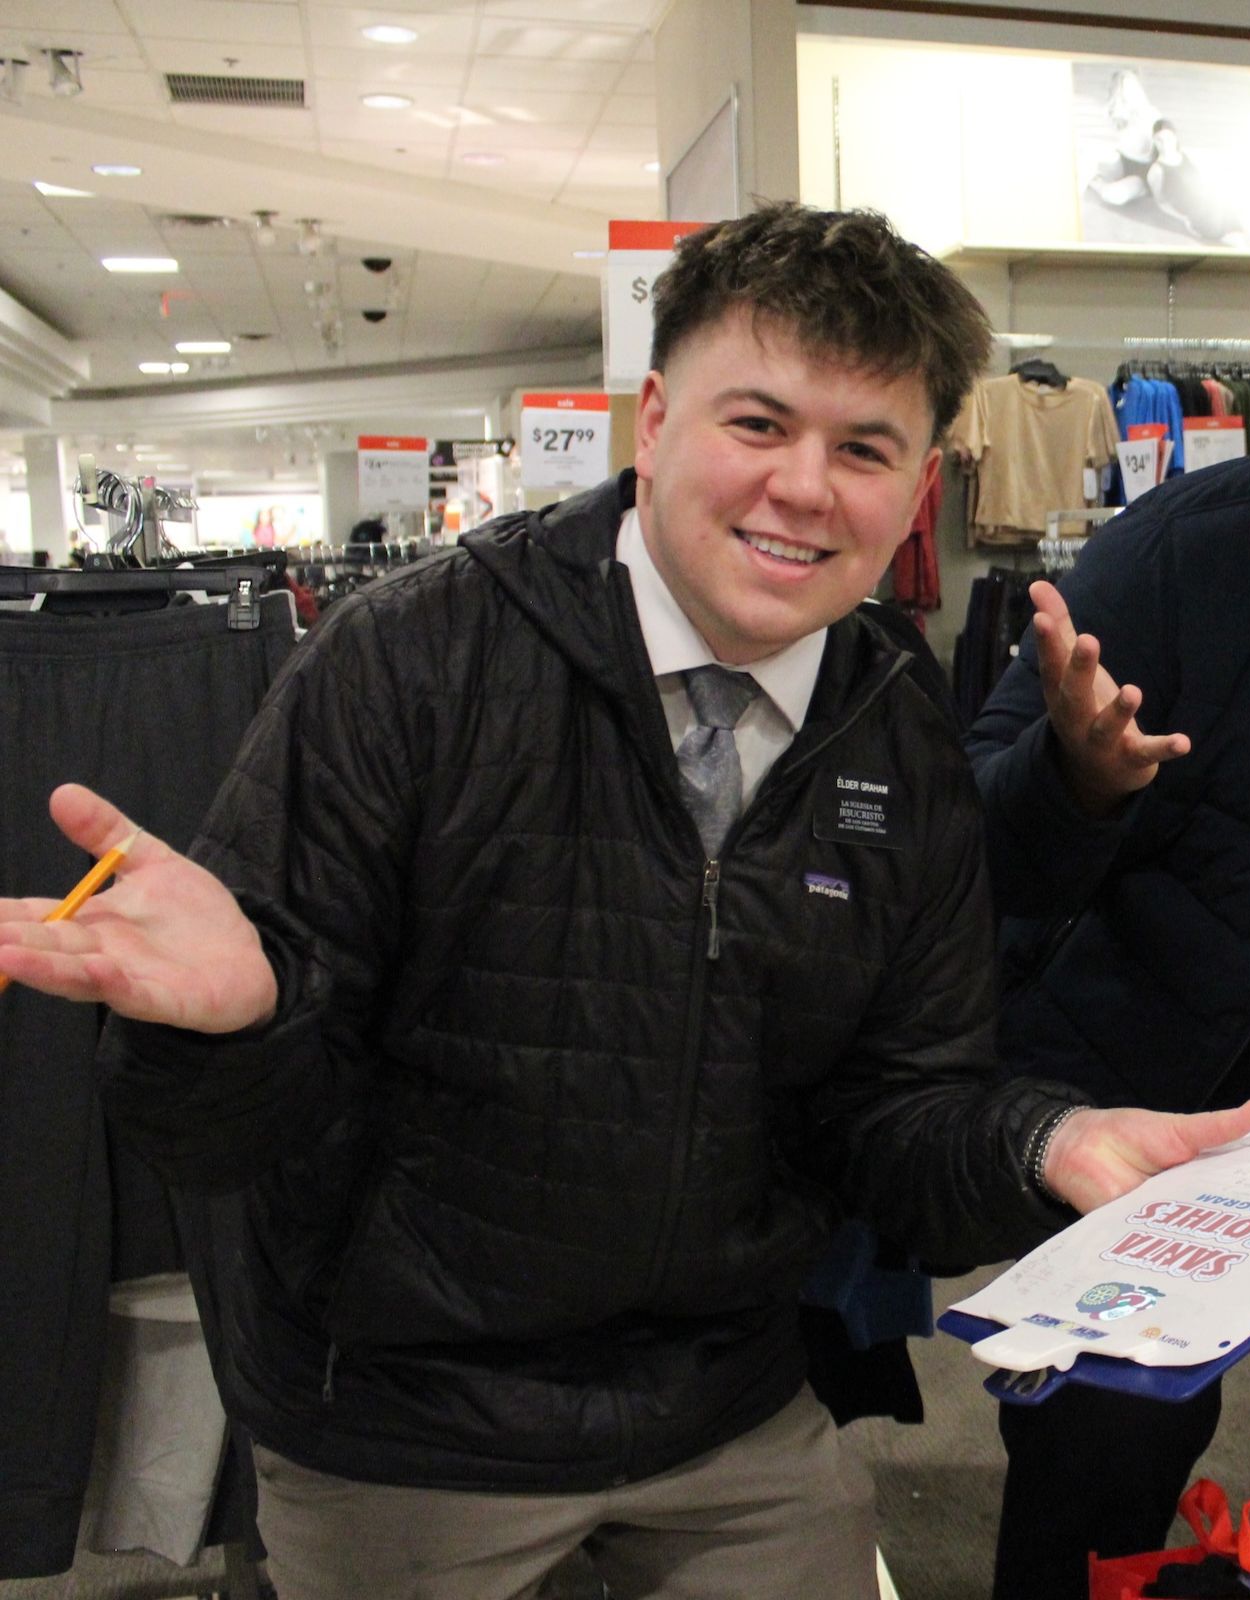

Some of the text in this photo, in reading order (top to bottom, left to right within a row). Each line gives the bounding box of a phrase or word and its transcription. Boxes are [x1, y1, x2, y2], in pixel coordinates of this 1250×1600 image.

[861, 782, 889, 794] GRAHAM
[849, 801, 873, 811] IGLESIA
[839, 807, 885, 822] JESUCRISTO
[1105, 1231, 1245, 1279] SANTA
[1160, 1334, 1191, 1349] Rotary
